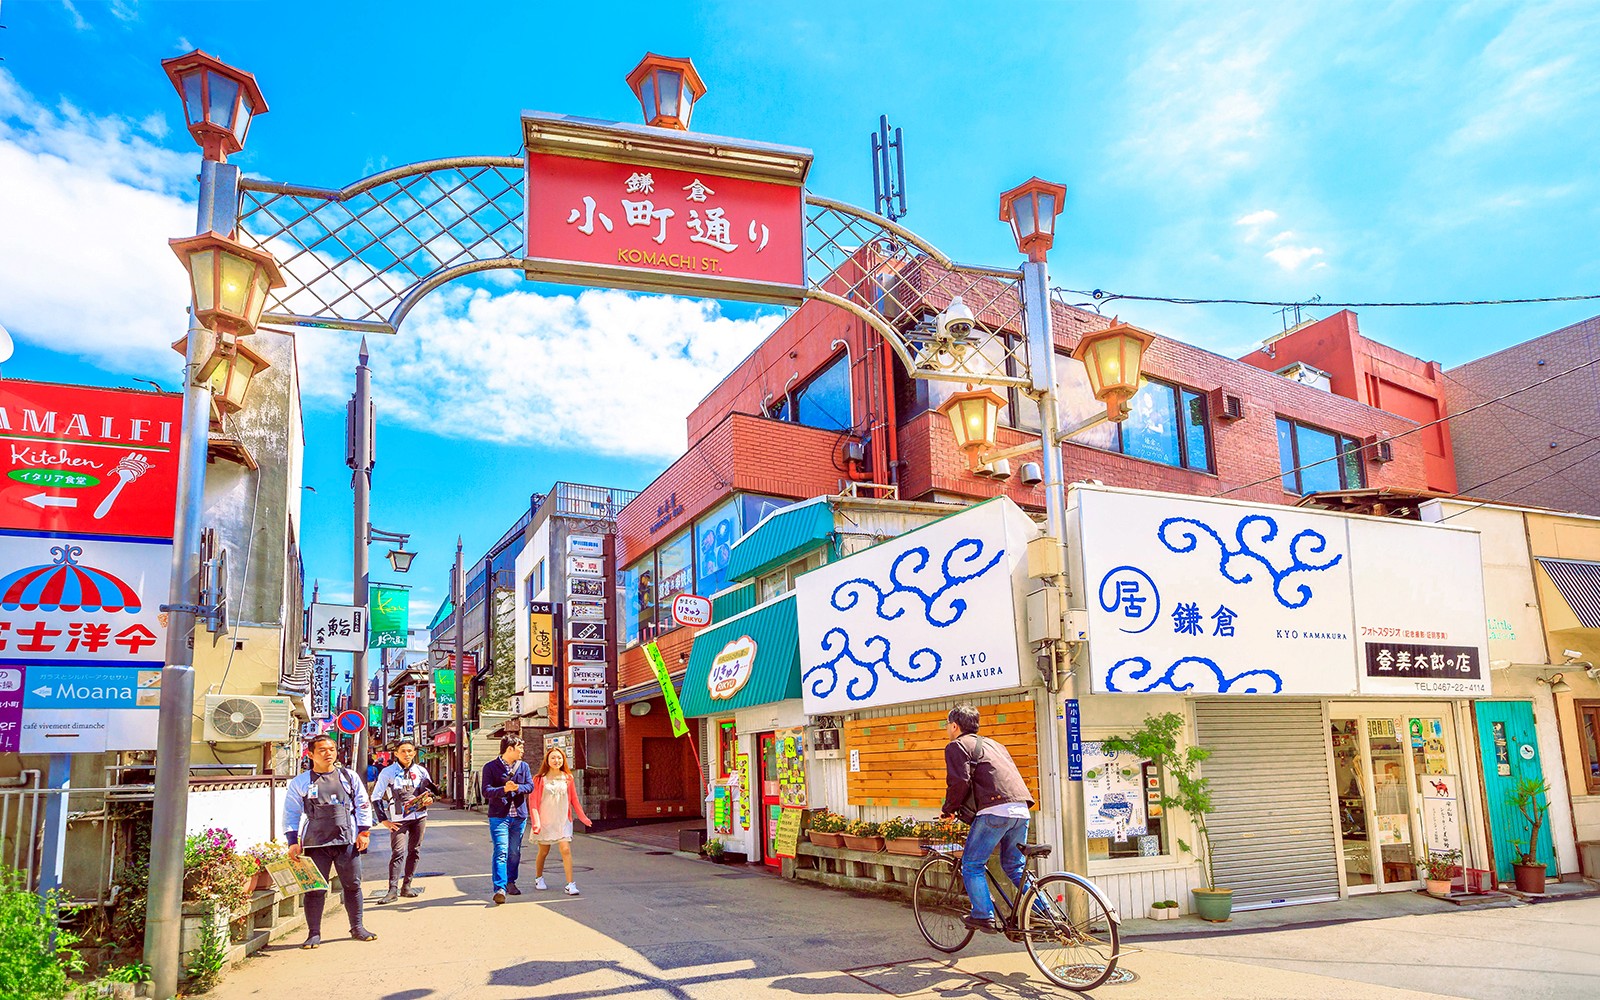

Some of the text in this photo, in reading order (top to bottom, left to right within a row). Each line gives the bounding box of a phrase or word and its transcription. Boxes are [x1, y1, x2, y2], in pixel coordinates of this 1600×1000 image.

[624, 172, 715, 202] 鎌倉
[567, 196, 770, 253] 小町通り
[618, 248, 723, 273] KOMACHI ST.
[11, 444, 104, 469] Kitchen
[20, 471, 87, 486] イタリア食堂
[679, 598, 697, 606] かまくら
[678, 606, 700, 616] りきゅう
[682, 615, 702, 623] RIKYU
[1171, 602, 1239, 638] 鎌倉
[1276, 629, 1348, 641] KYO KAMAKURA
[1361, 626, 1401, 637] フォトスタジオ
[960, 651, 986, 666] KYO
[1376, 649, 1471, 673] 登美太郎の店
[713, 660, 740, 682] りきゅう
[949, 666, 1003, 683] KAMAKURA
[56, 683, 132, 699] Moana
[23, 722, 105, 730] café vivement dimanche
[586, 718, 604, 726] てまり
[1070, 709, 1079, 751] 小町二丁目
[1070, 753, 1081, 763] 10
